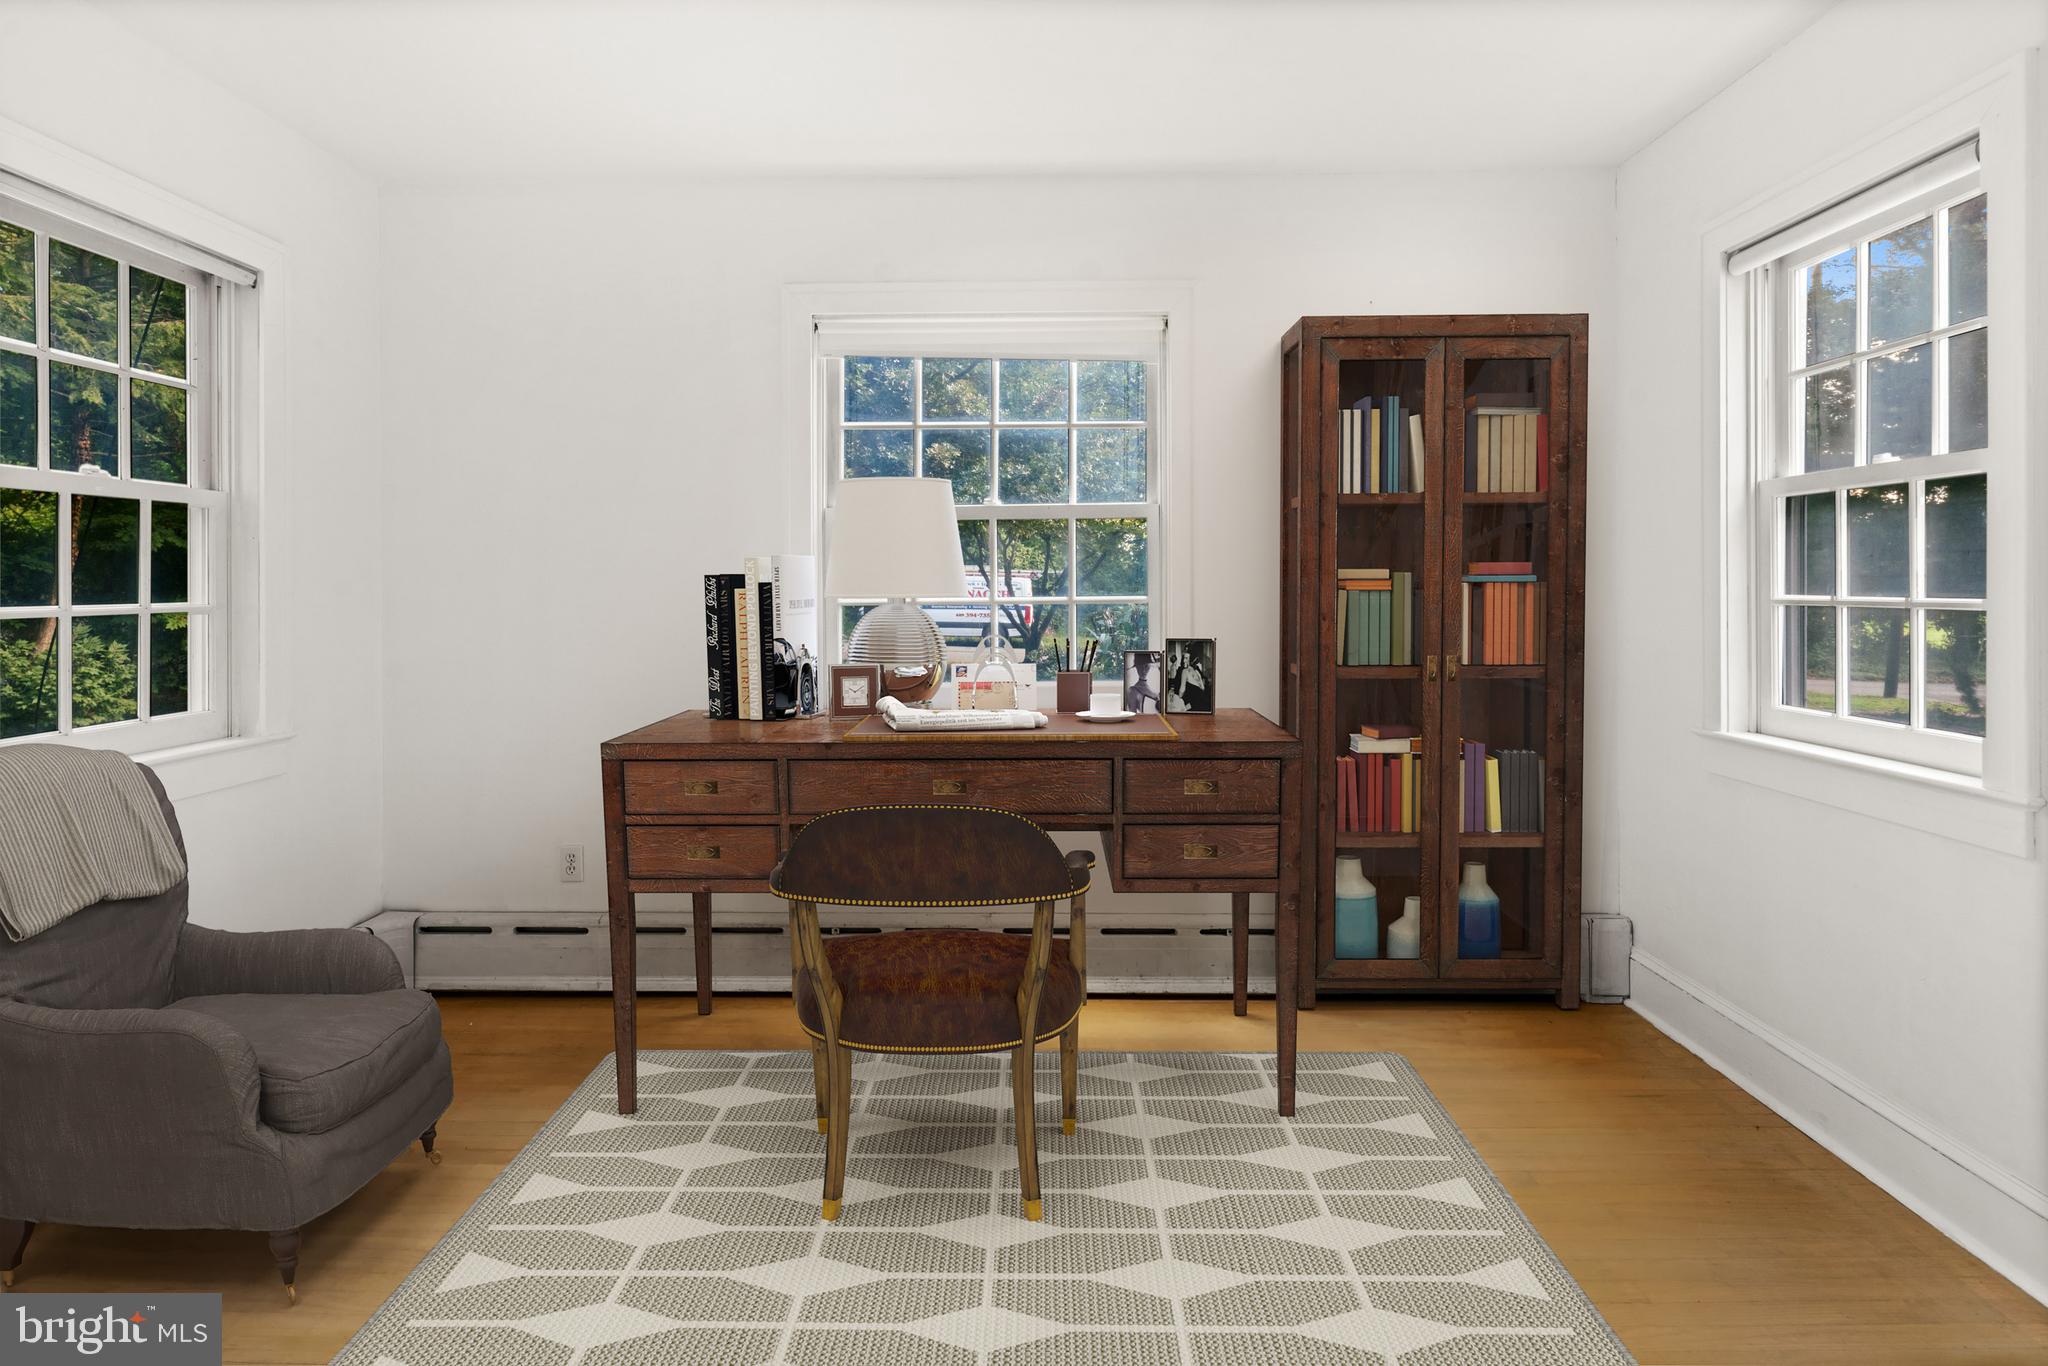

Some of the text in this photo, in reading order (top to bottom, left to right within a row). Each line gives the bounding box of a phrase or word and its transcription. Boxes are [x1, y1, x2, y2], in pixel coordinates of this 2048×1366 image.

[720, 590, 729, 624] YEARS
[706, 610, 719, 651] Richard
[721, 627, 730, 647] 100
[745, 559, 761, 717] PAINTING BEYOND POLLOCK
[764, 625, 774, 651] FAIR
[722, 648, 731, 674] FAIR
[738, 592, 751, 704] RALPH LAUREN
[765, 652, 775, 671] 100
[765, 672, 776, 706] YEARS
[709, 698, 722, 717] The
